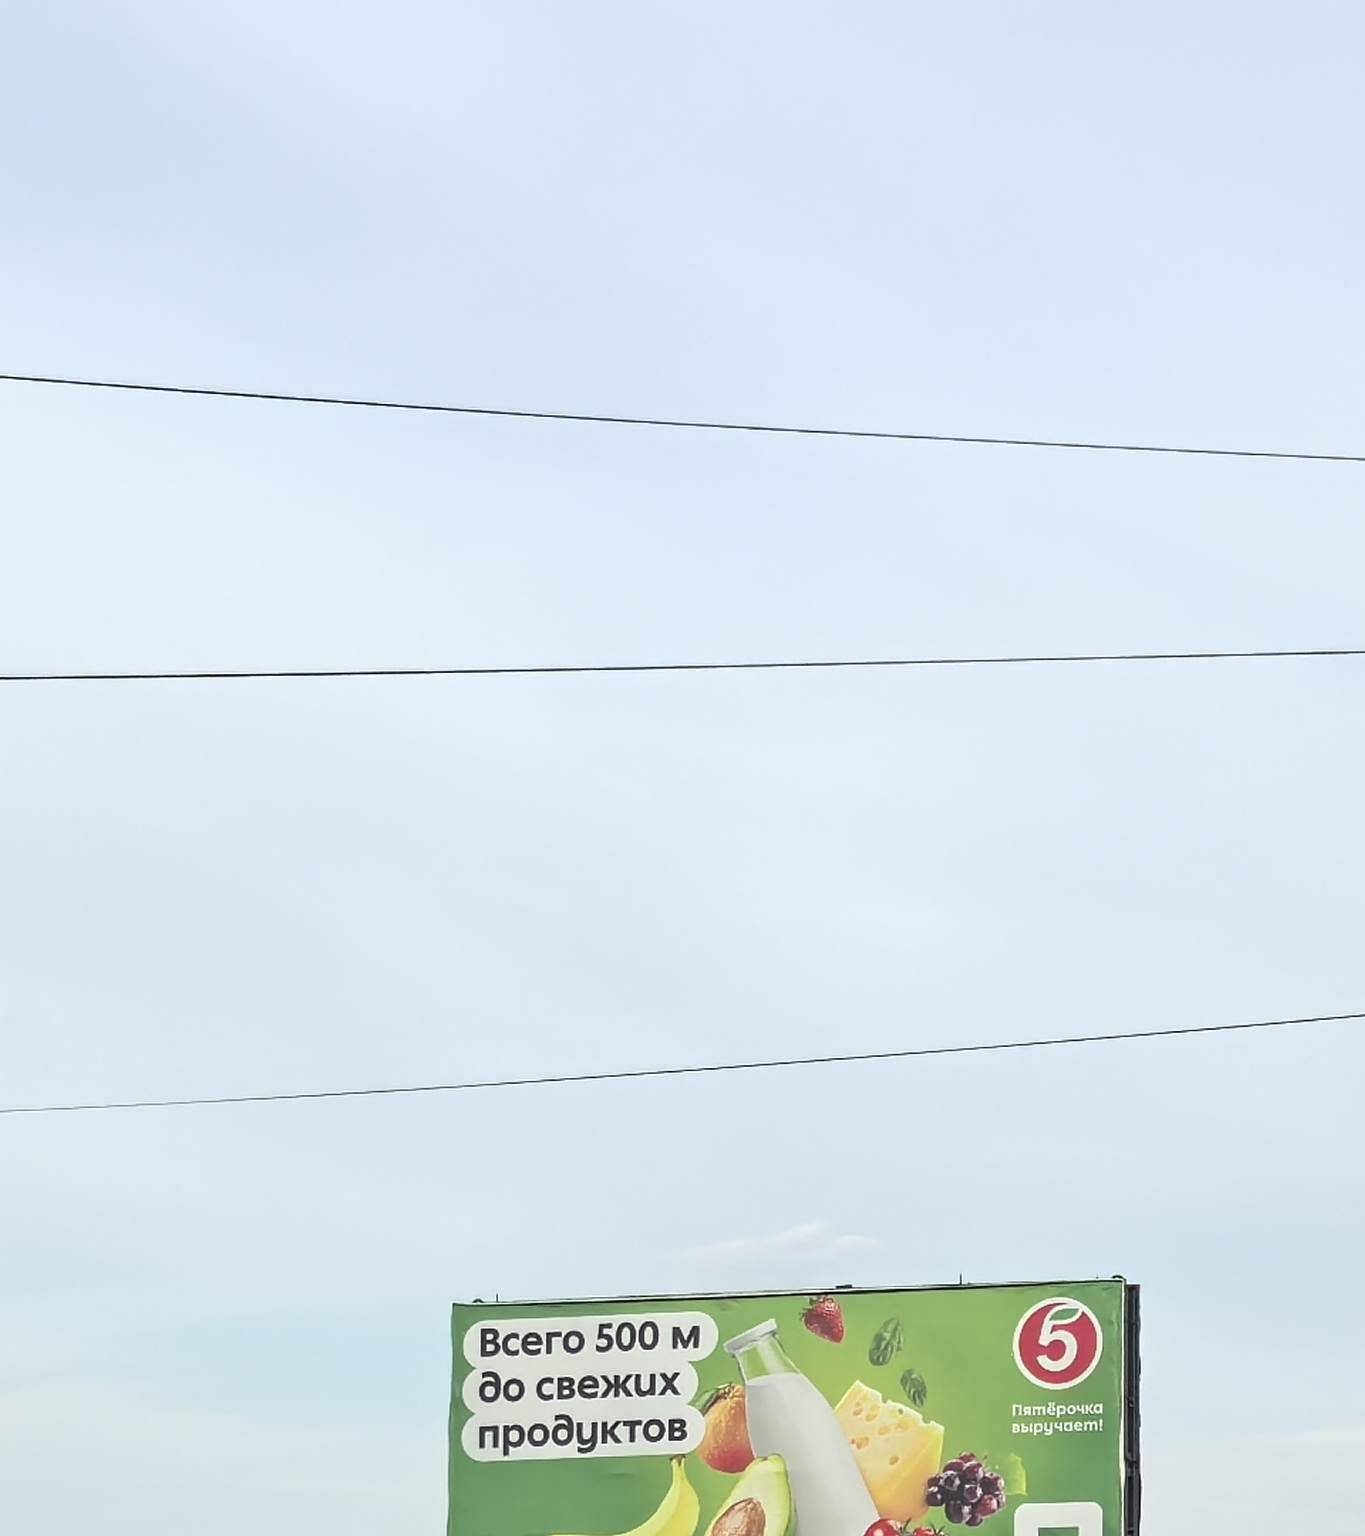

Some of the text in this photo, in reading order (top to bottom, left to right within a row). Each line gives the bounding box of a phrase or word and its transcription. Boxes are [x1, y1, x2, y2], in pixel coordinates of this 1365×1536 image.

[480, 1321, 700, 1357] Всего 500 м
[1037, 1304, 1084, 1372] 5
[479, 1371, 681, 1402] до свежих
[1012, 1402, 1103, 1418] Пятёрочка
[479, 1414, 687, 1456] продуктов
[1012, 1419, 1103, 1436] выручает!
